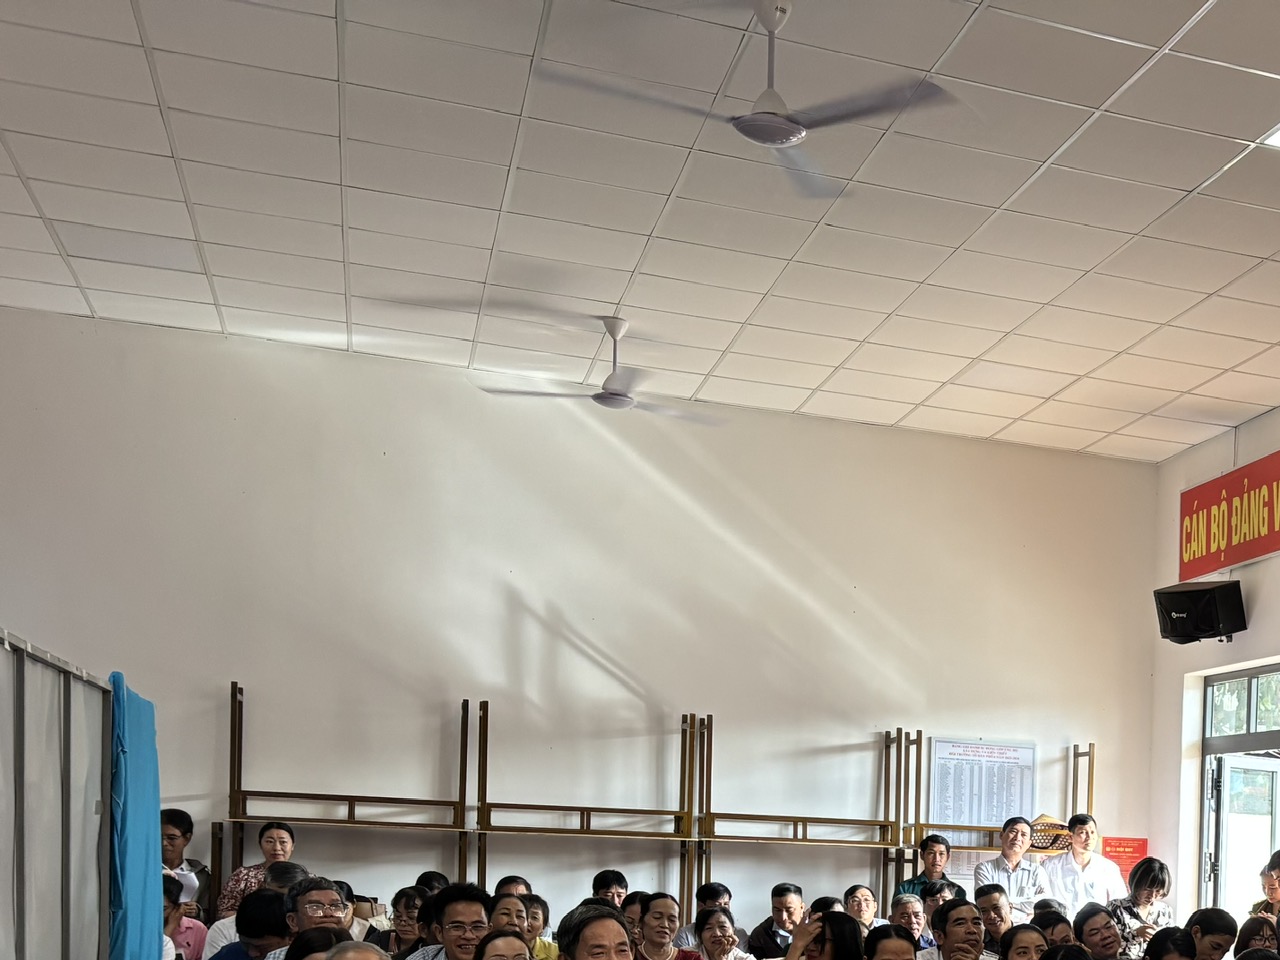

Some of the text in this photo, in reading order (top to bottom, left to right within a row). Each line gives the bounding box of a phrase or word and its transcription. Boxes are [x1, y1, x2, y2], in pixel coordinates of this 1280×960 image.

[1182, 500, 1207, 563] CÁN
[1210, 489, 1228, 561] BỘ
[1231, 478, 1269, 546] ĐẢNG
